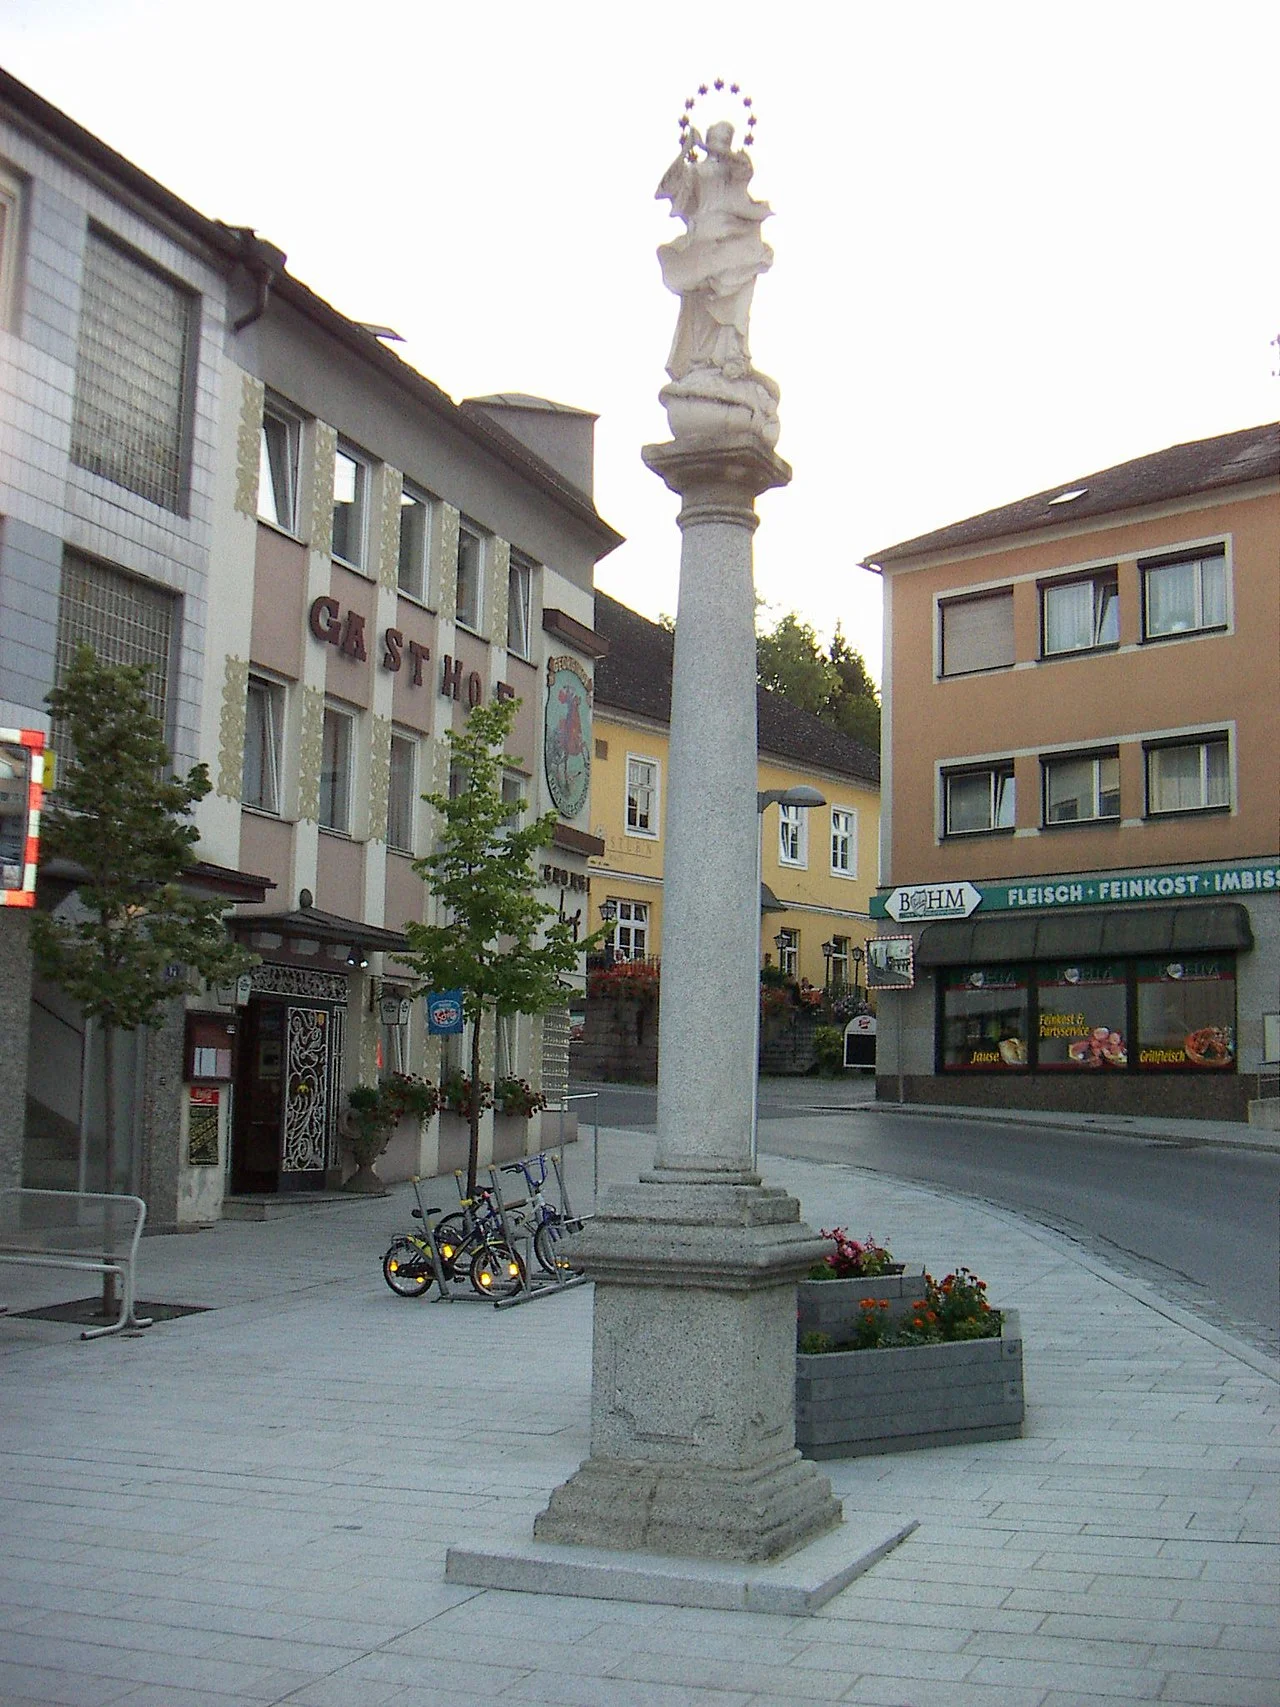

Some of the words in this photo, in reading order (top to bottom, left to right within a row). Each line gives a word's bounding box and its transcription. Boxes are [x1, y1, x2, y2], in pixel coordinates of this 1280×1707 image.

[1008, 883, 1083, 906] FLEISCH
[1099, 875, 1199, 900] FEINKOST
[1040, 1014, 1074, 1025] Feinkost
[1040, 1025, 1089, 1038] Partyservice
[971, 1051, 1000, 1064] Jause
[1140, 1050, 1186, 1064] Grillfleisch
